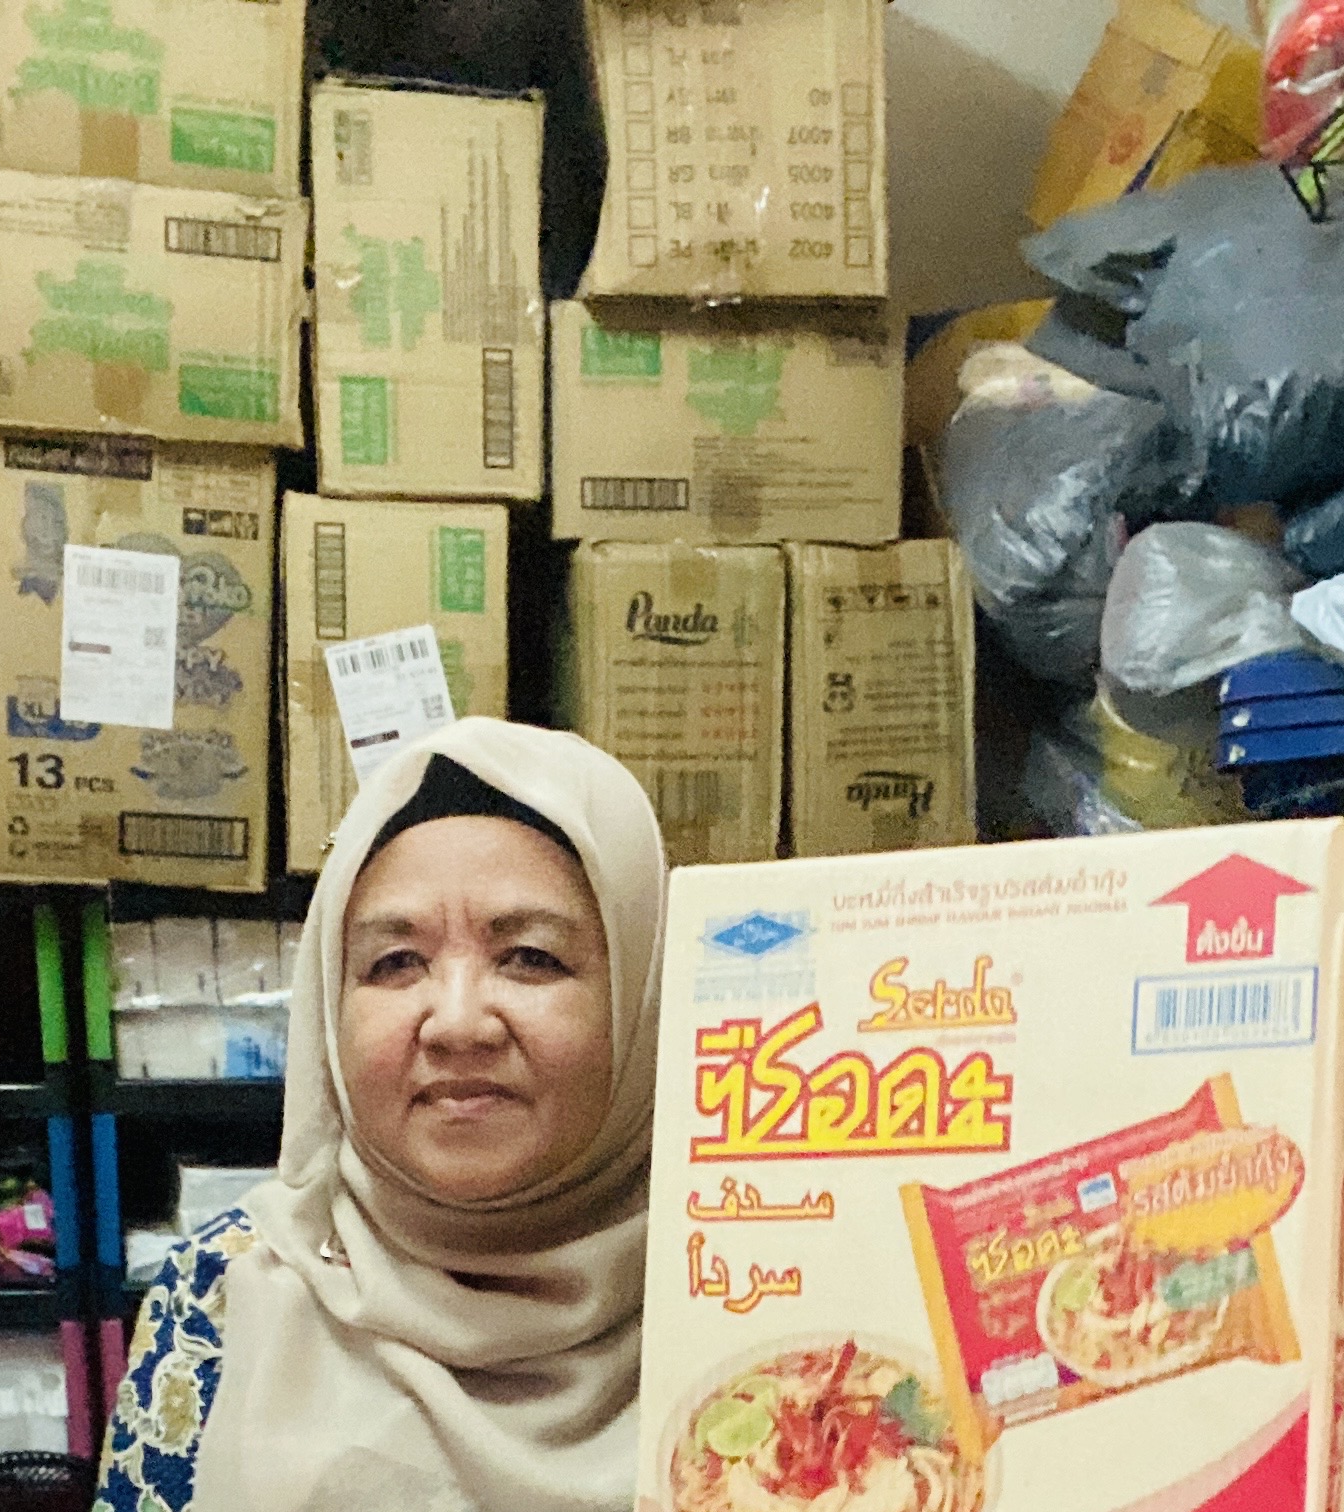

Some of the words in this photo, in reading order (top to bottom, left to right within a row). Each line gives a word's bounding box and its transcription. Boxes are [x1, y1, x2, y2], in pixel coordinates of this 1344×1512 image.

[626, 590, 719, 642] Panda
[7, 752, 65, 790] 13
[859, 955, 1017, 1031] Serda
